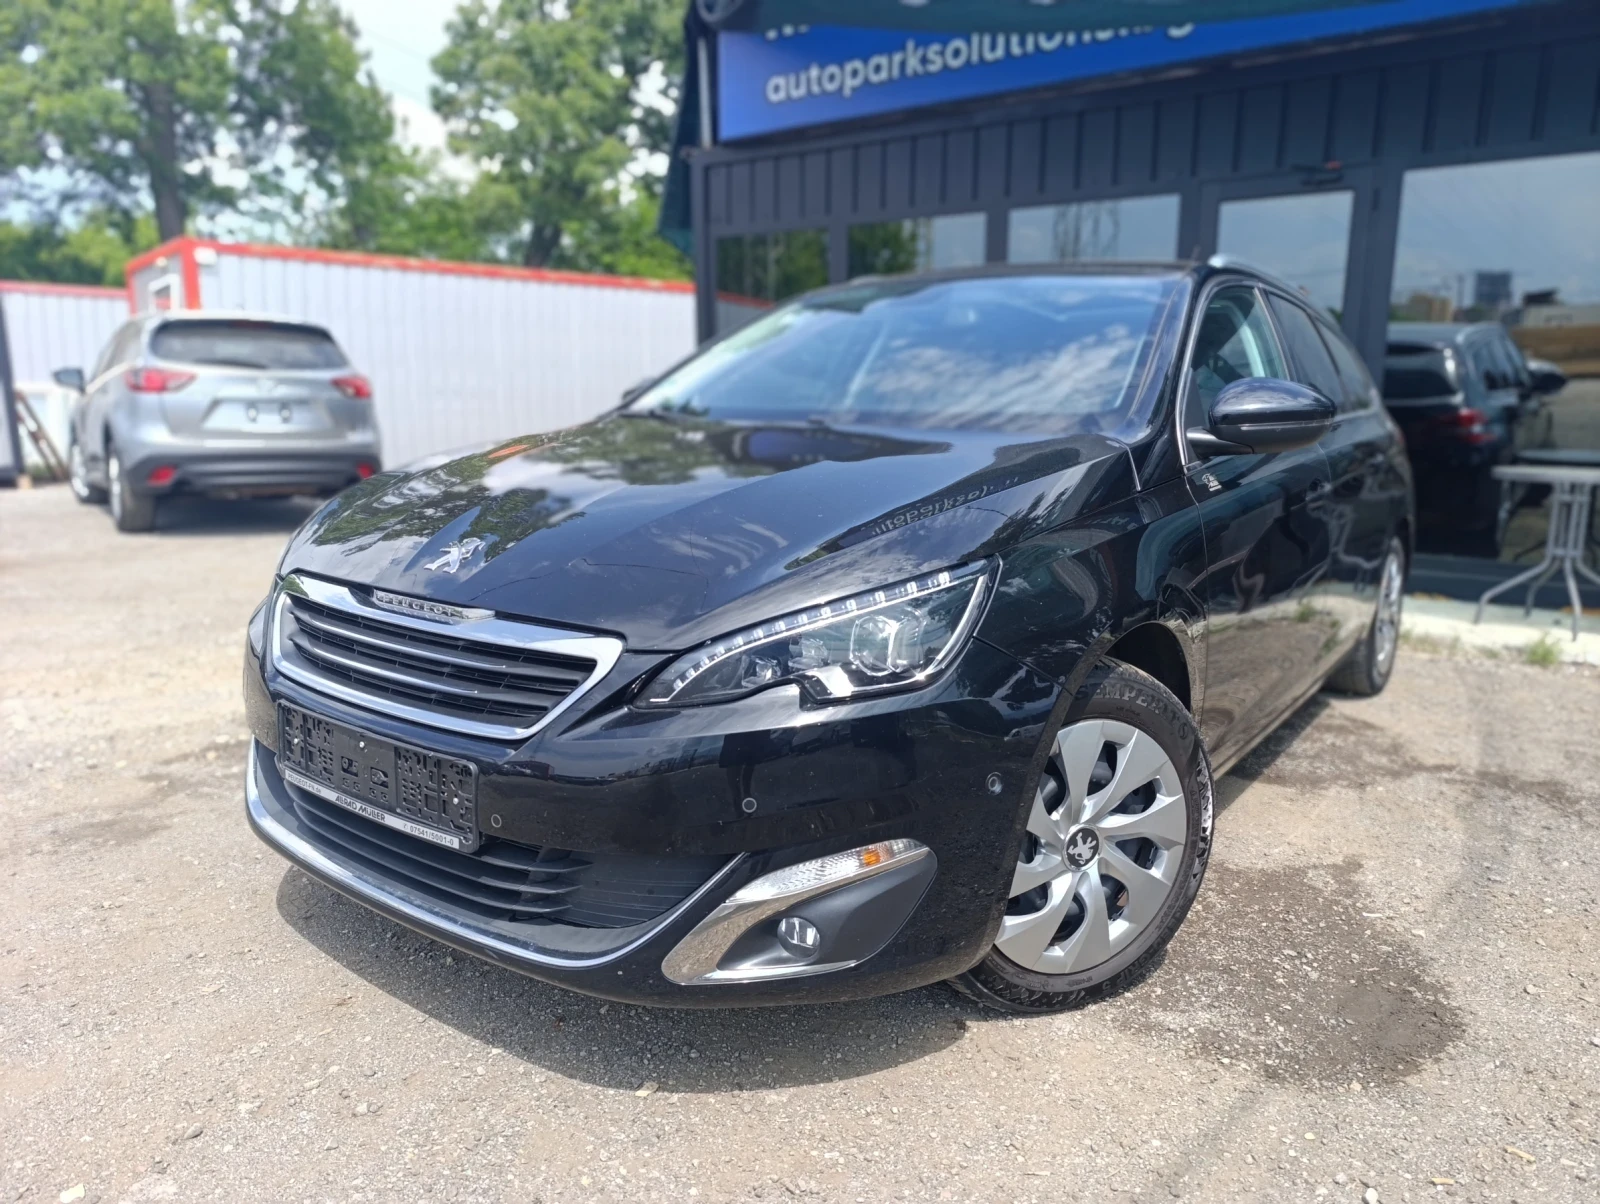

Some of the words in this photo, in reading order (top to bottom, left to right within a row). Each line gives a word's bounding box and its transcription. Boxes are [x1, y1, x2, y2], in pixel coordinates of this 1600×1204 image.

[383, 594, 453, 616] PEUGEOT
[1075, 682, 1180, 724] SEMPERIT
[335, 795, 358, 810] ALLRAD
[410, 825, 454, 846] 07541/5001-0
